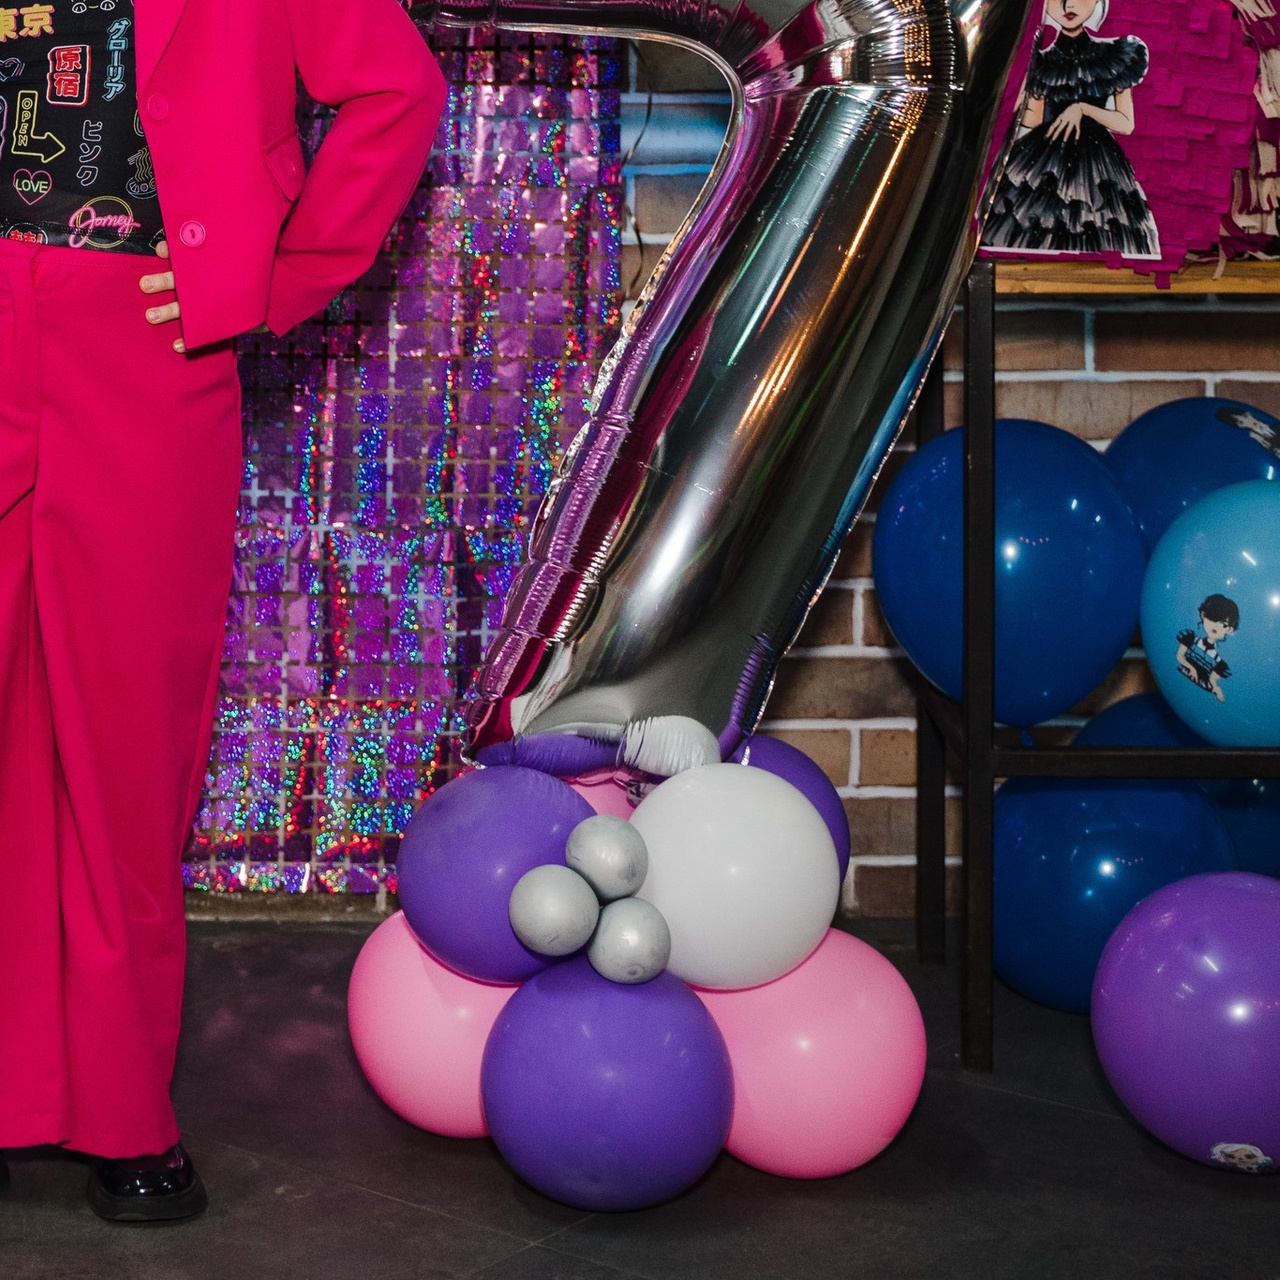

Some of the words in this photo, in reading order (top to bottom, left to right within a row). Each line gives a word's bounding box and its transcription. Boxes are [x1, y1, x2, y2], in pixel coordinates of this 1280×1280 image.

[53, 47, 81, 98] 原宿
[102, 17, 131, 101] グローリア
[18, 97, 33, 146] OPEN
[15, 178, 49, 194] LOVE
